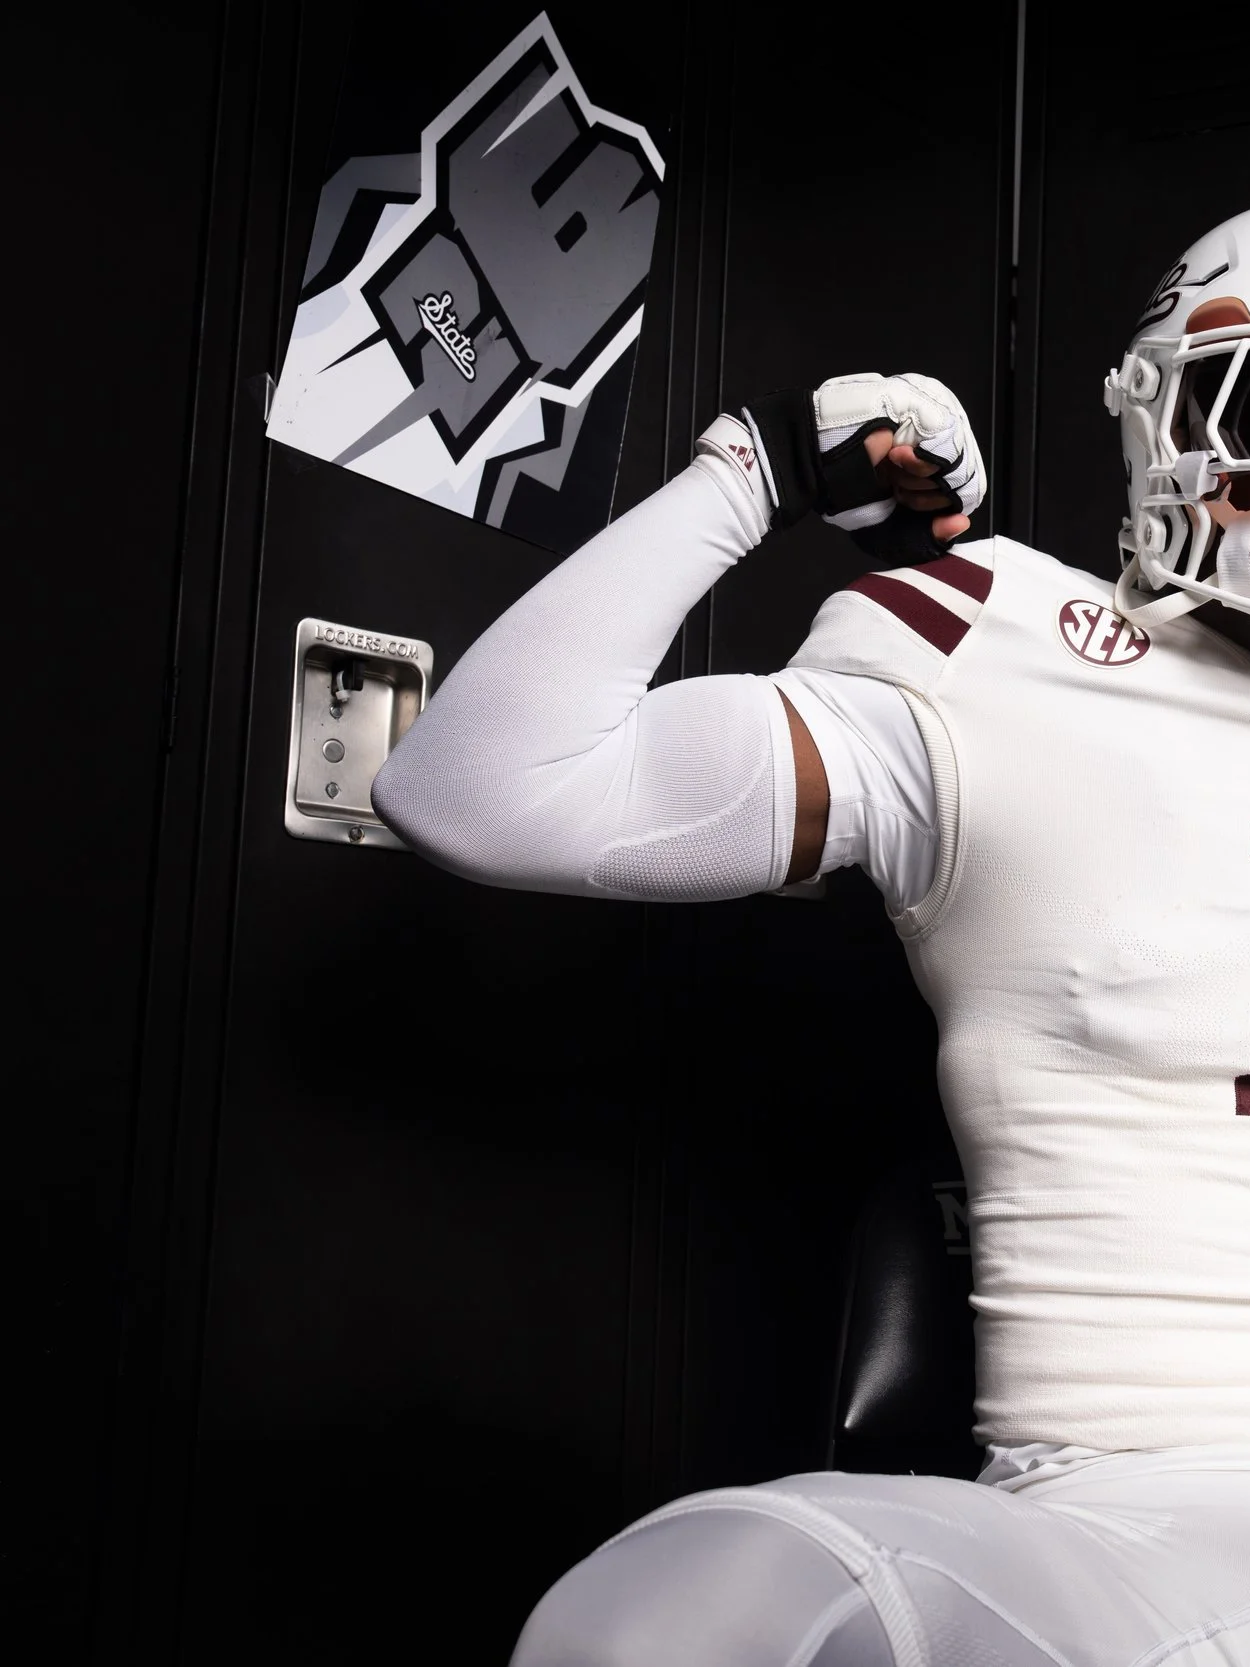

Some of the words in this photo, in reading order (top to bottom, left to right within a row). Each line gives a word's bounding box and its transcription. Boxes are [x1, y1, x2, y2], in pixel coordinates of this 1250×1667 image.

[418, 293, 476, 380] State
[315, 625, 419, 659] LOCKERS.COM
[1063, 602, 1145, 662] SEC
